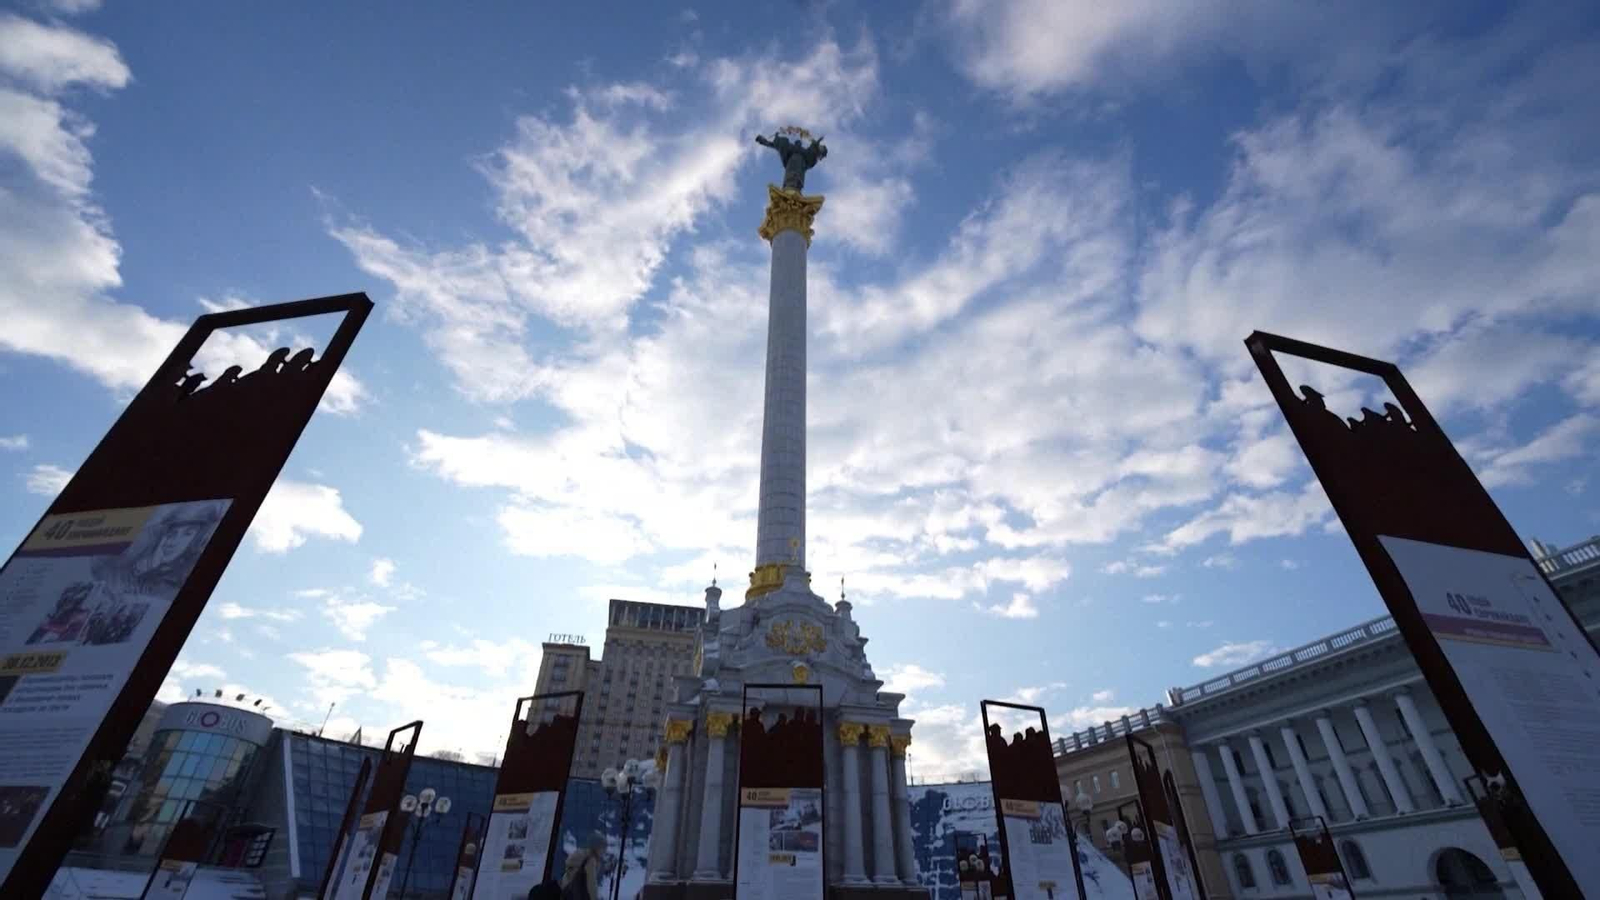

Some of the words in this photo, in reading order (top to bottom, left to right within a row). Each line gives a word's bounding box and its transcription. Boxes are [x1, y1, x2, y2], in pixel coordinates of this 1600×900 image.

[1446, 592, 1472, 615] 40
[548, 633, 587, 644] ГОТЕЛЬ
[746, 791, 757, 801] 40
